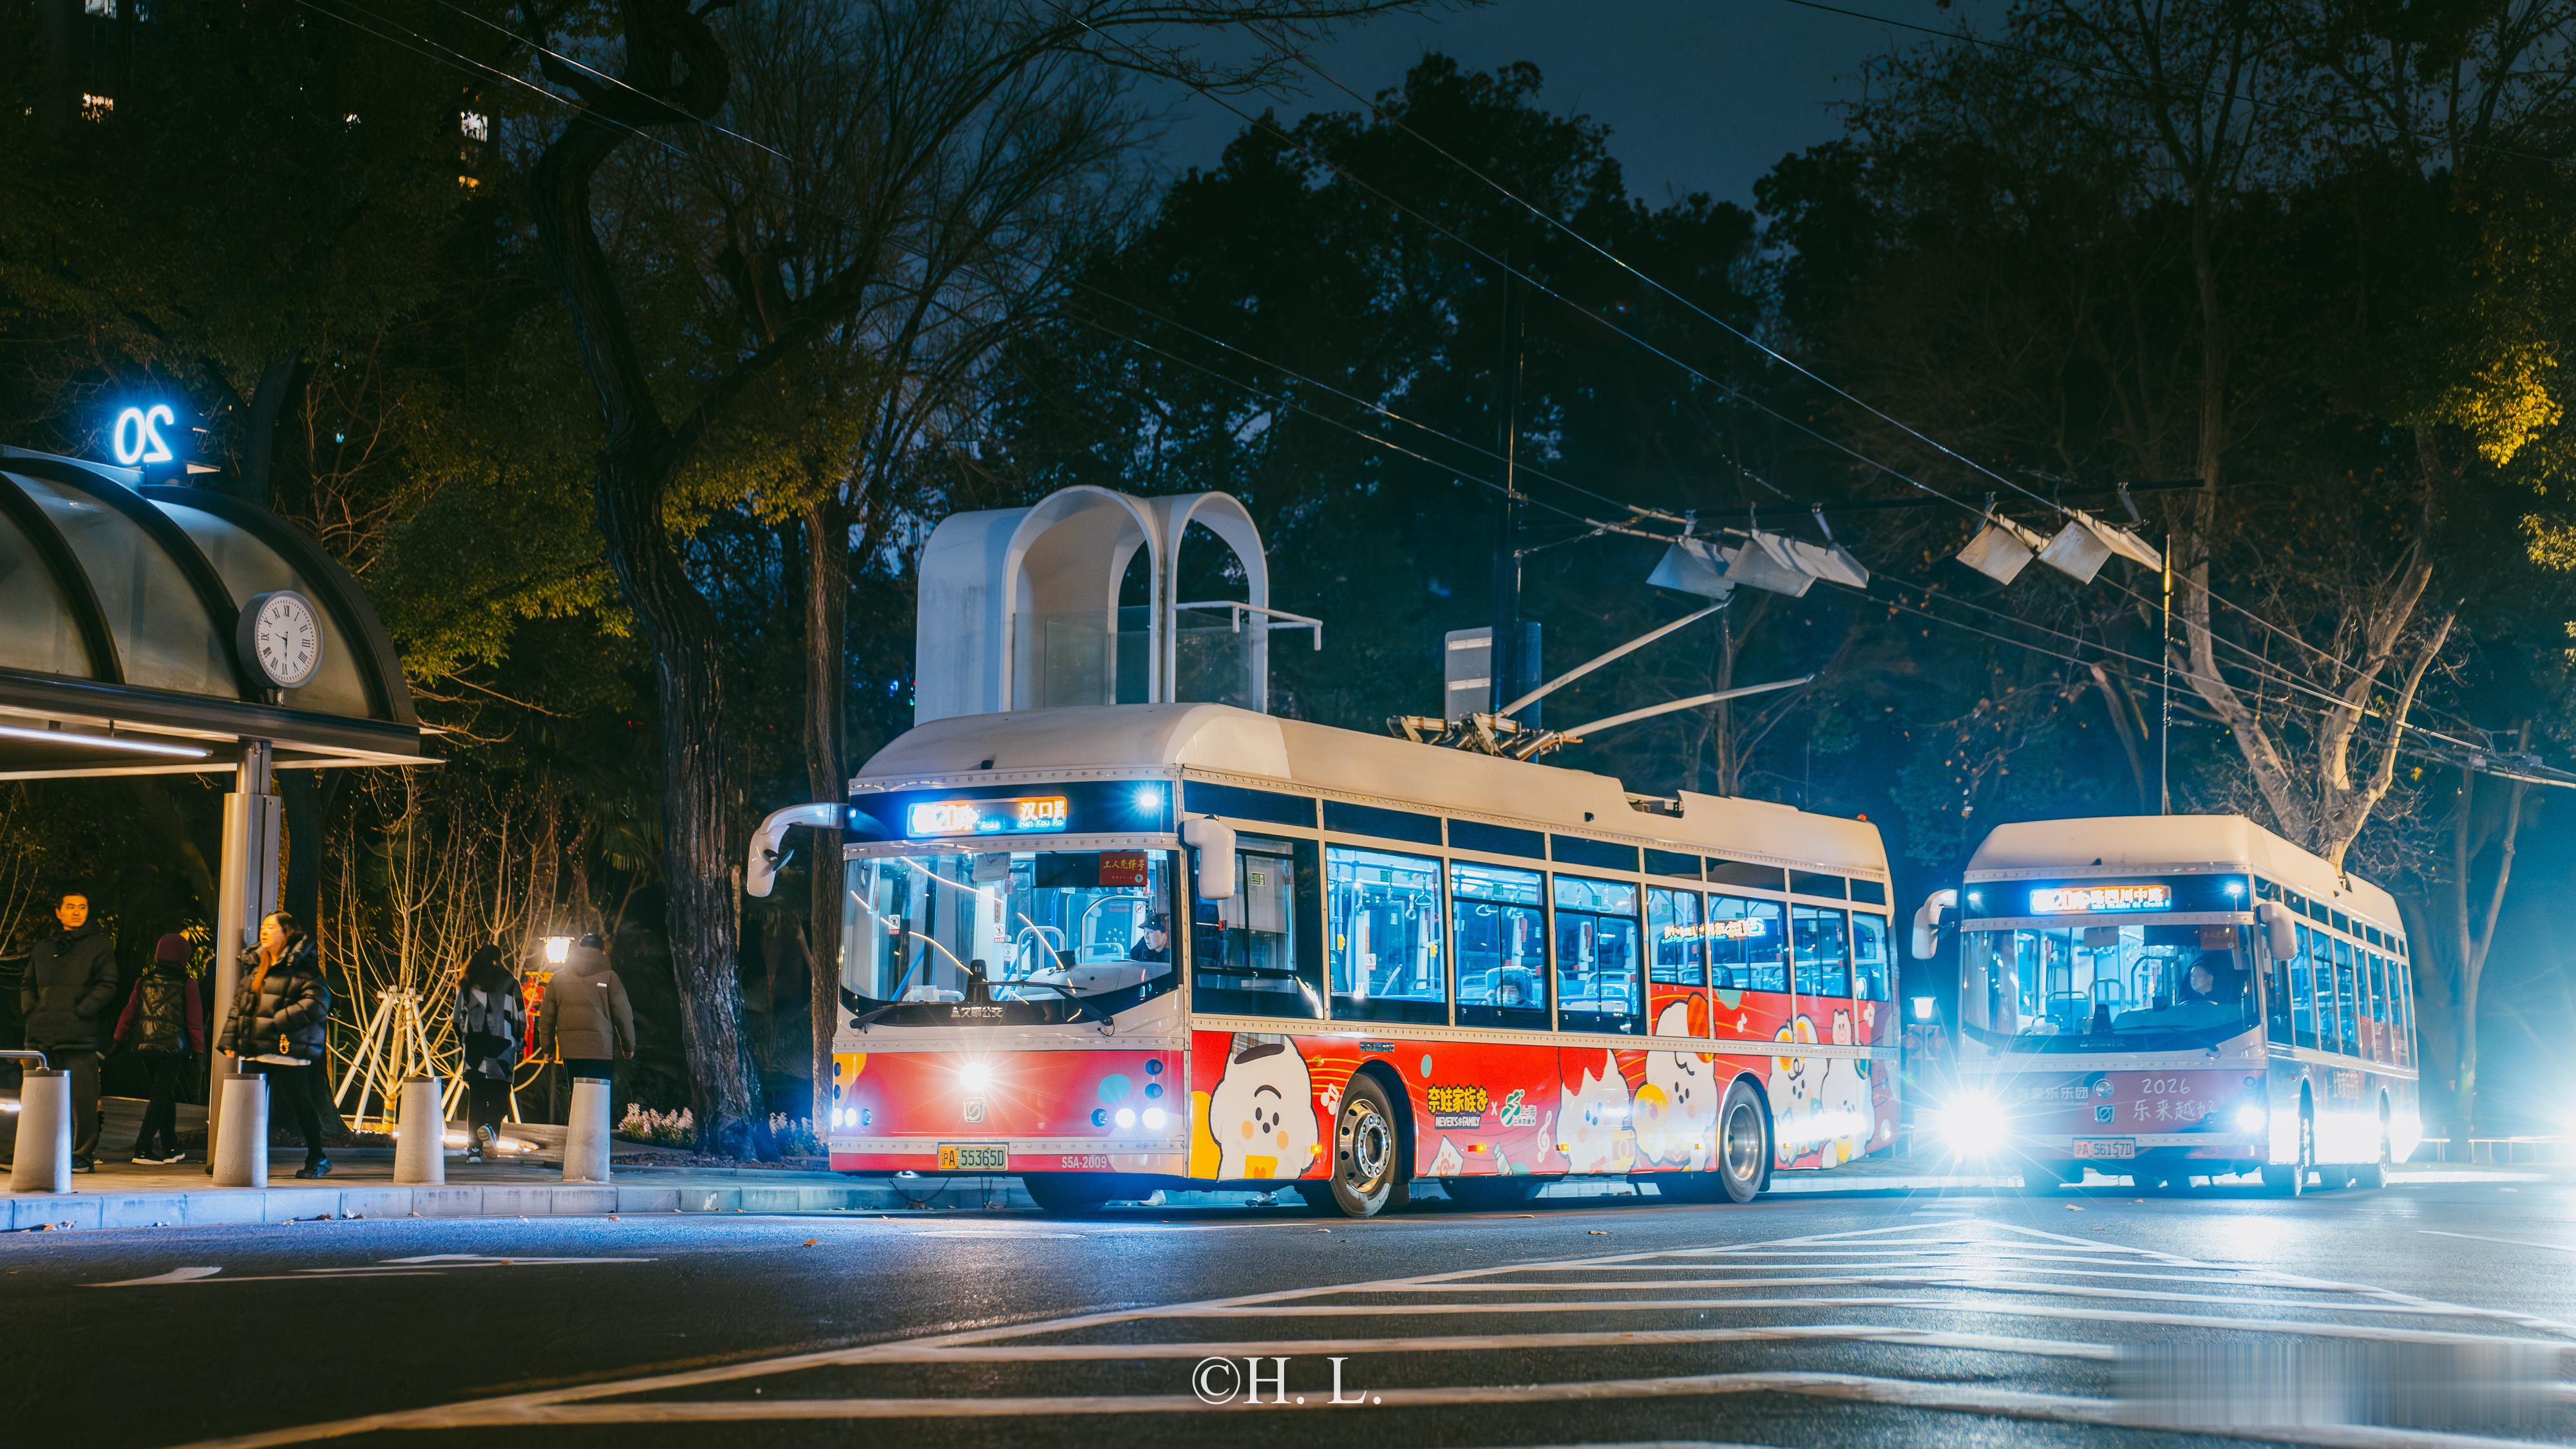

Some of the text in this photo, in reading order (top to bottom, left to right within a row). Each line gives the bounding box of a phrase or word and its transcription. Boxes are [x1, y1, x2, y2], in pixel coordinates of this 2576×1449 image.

[302, 639, 310, 648] III
[2141, 1078, 2190, 1094] 2026
[2093, 1143, 2132, 1155] 56157D
[961, 1150, 1004, 1166] 55365D
[1061, 1156, 1108, 1169] S5A-2009
